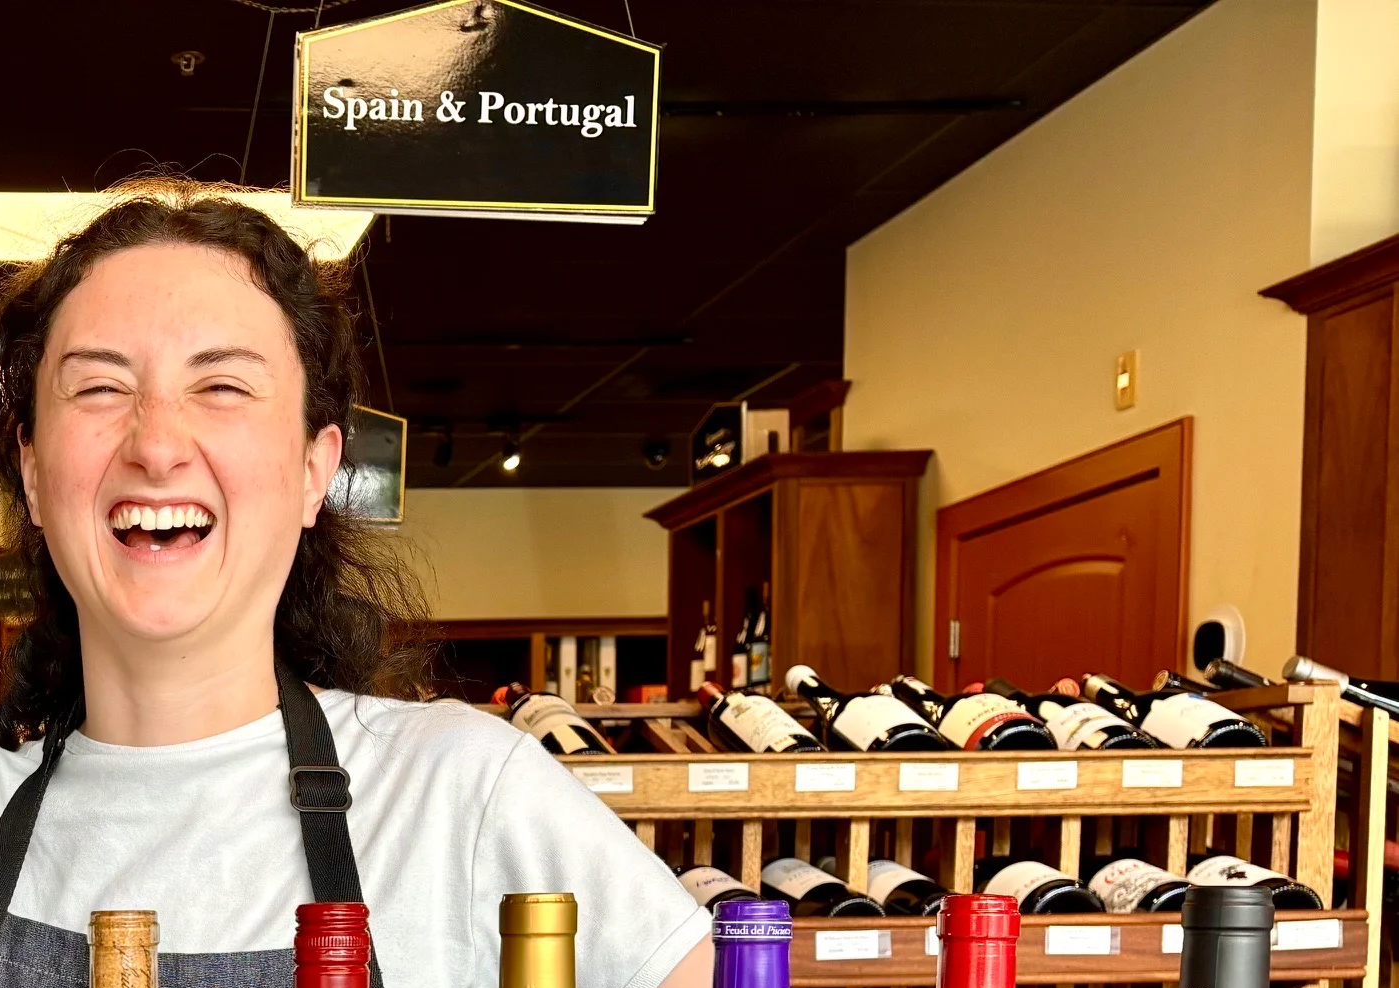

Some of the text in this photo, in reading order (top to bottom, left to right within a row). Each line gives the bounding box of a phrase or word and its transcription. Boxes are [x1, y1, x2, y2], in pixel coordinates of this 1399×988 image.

[322, 87, 638, 138] Spain & Portugal
[725, 925, 749, 935] Feudi
[751, 925, 764, 935] del
